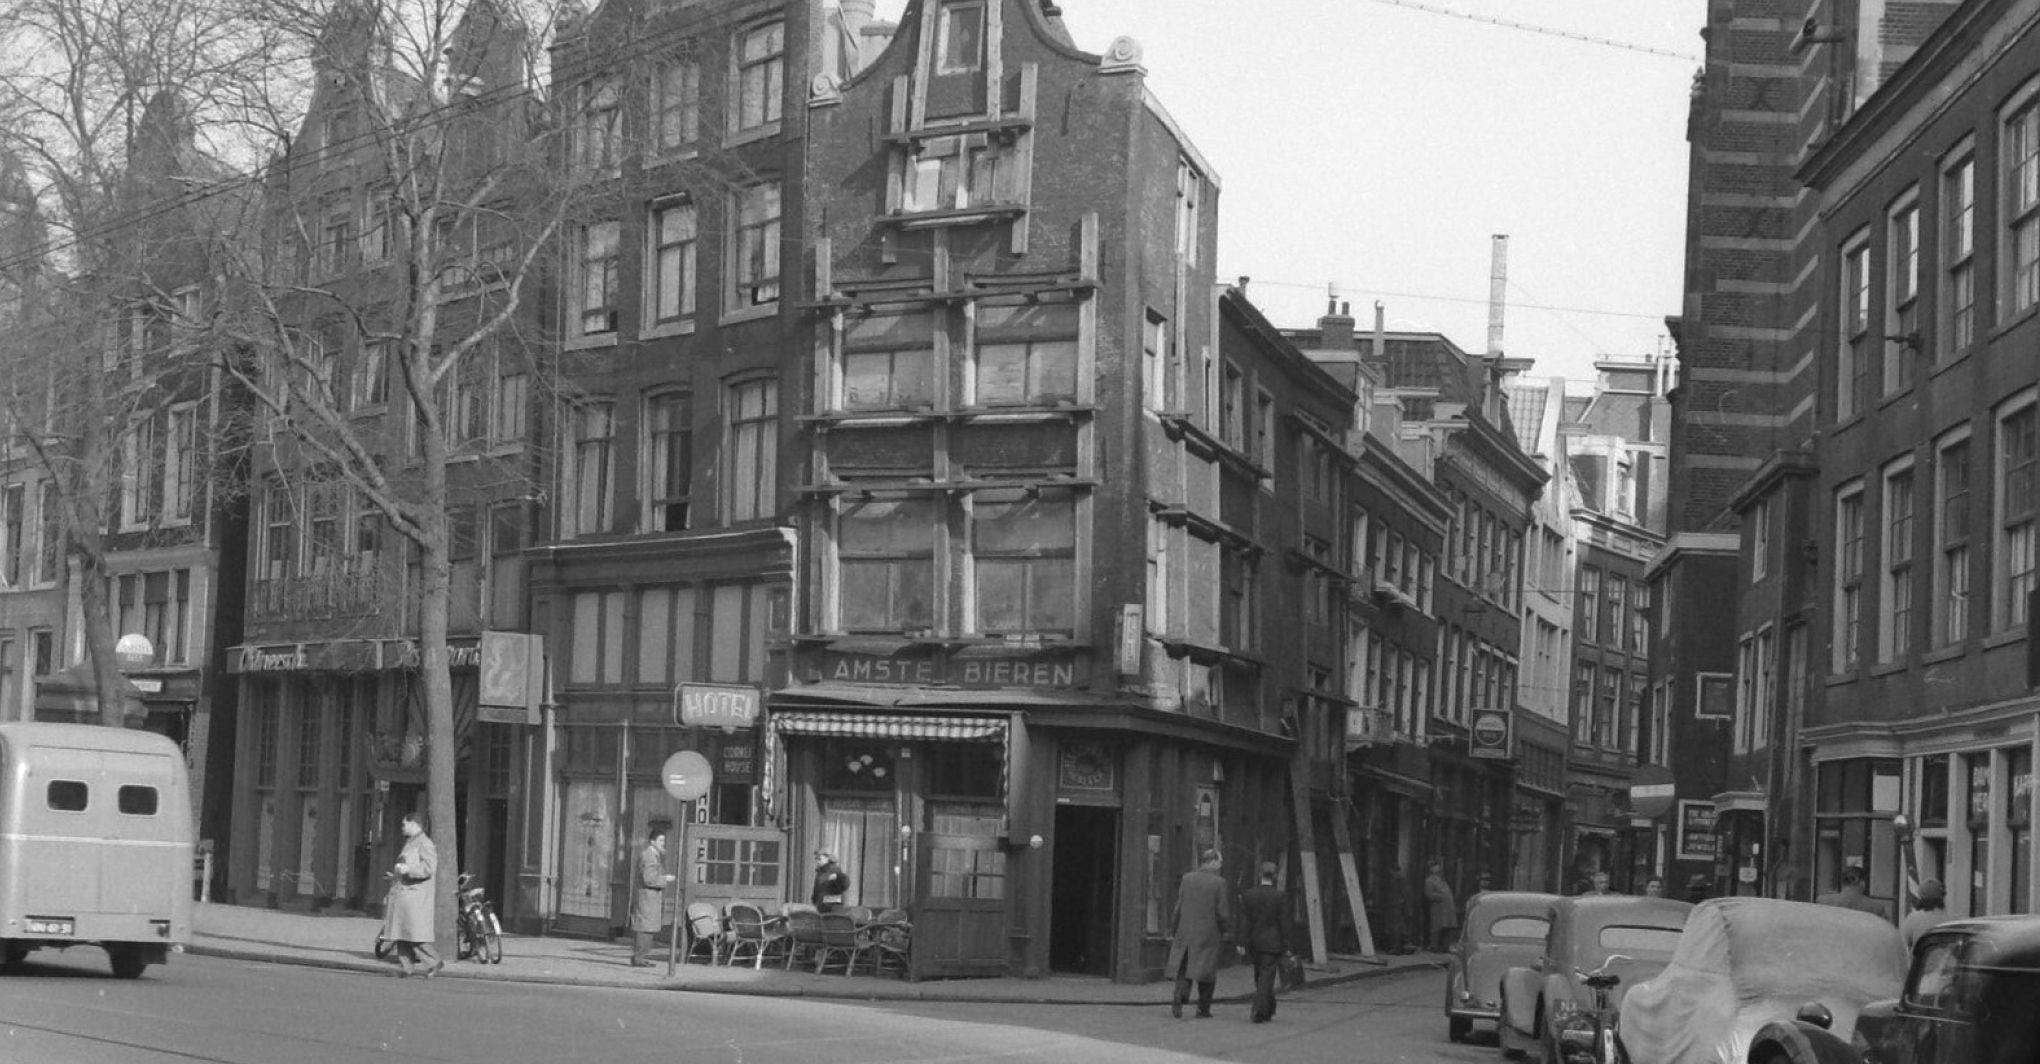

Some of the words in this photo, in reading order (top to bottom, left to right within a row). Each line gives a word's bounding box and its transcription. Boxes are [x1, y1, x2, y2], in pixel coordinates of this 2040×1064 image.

[833, 658, 945, 684] AMSTE
[964, 661, 1074, 686] BIEREN
[685, 691, 753, 720] HOTEL
[698, 791, 707, 883] HOEL
